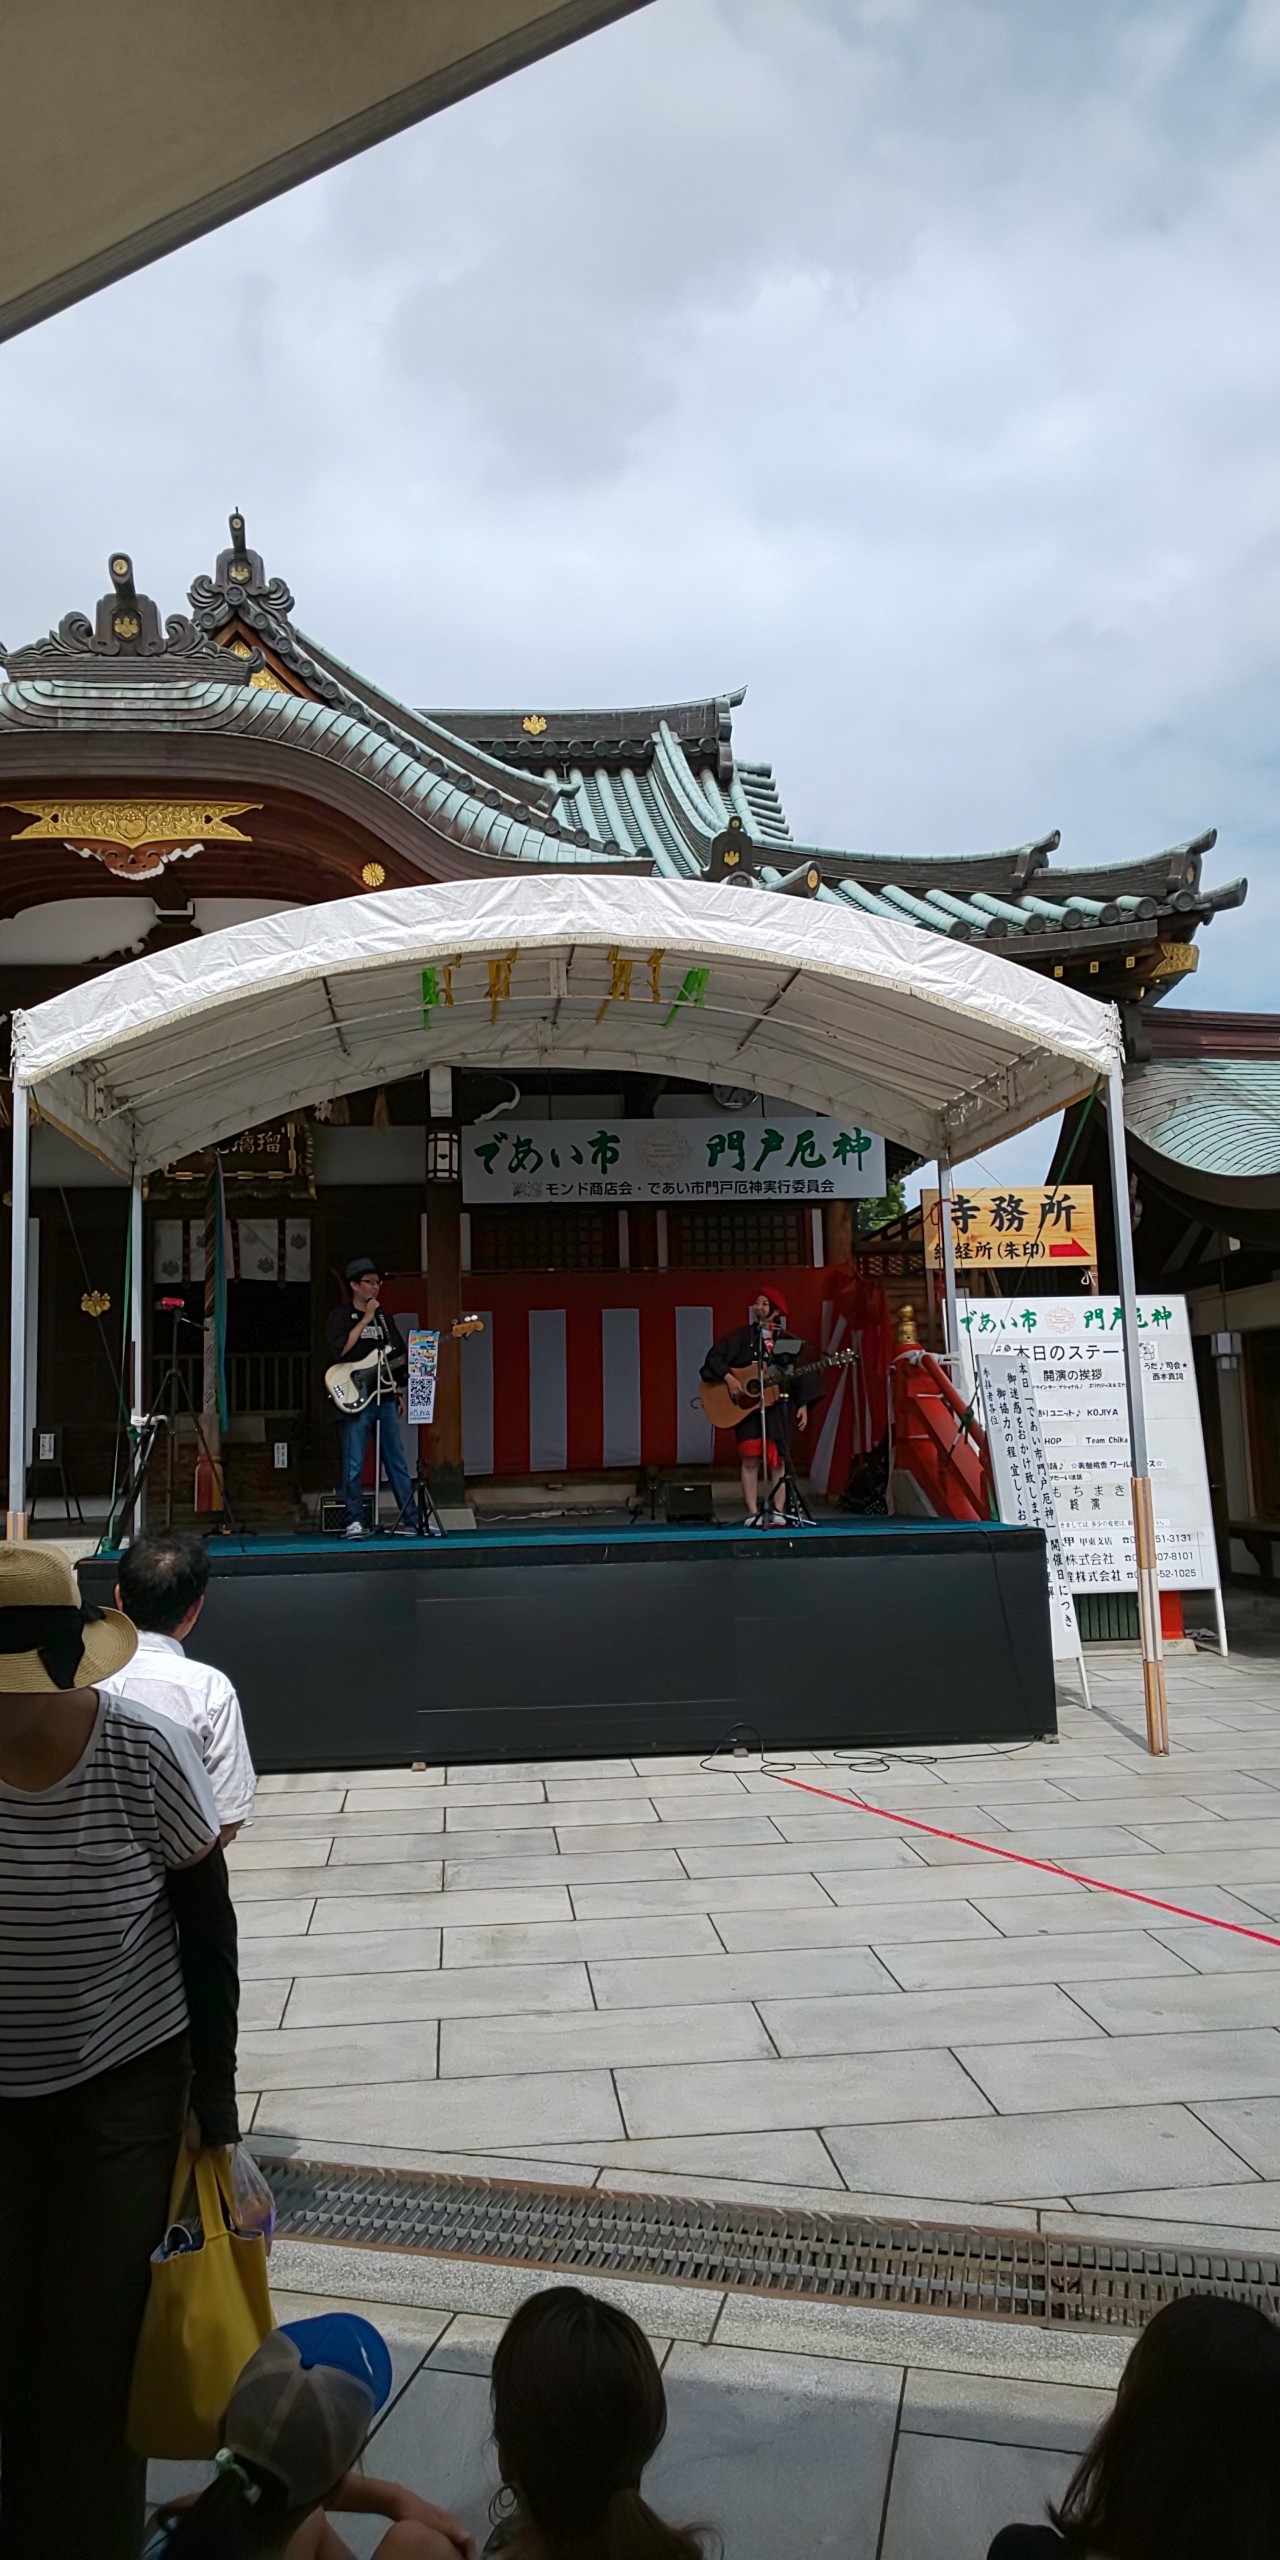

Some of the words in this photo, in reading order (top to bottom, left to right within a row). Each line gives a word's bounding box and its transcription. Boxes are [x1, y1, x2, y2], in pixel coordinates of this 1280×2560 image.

[474, 1130, 620, 1175] であい市
[706, 1127, 872, 1172] 門戸厄神
[951, 1193, 1076, 1234] 寺務所
[960, 1309, 1037, 1333] であい市
[1013, 1344, 1125, 1361] 本日のステー
[1043, 1368, 1102, 1382] 開演の挨拶
[1087, 1408, 1119, 1417] KOJIYA
[1044, 1437, 1062, 1445] HOP
[1086, 1437, 1105, 1445] Team
[997, 1387, 1028, 1527] 御協力の程宜しくお
